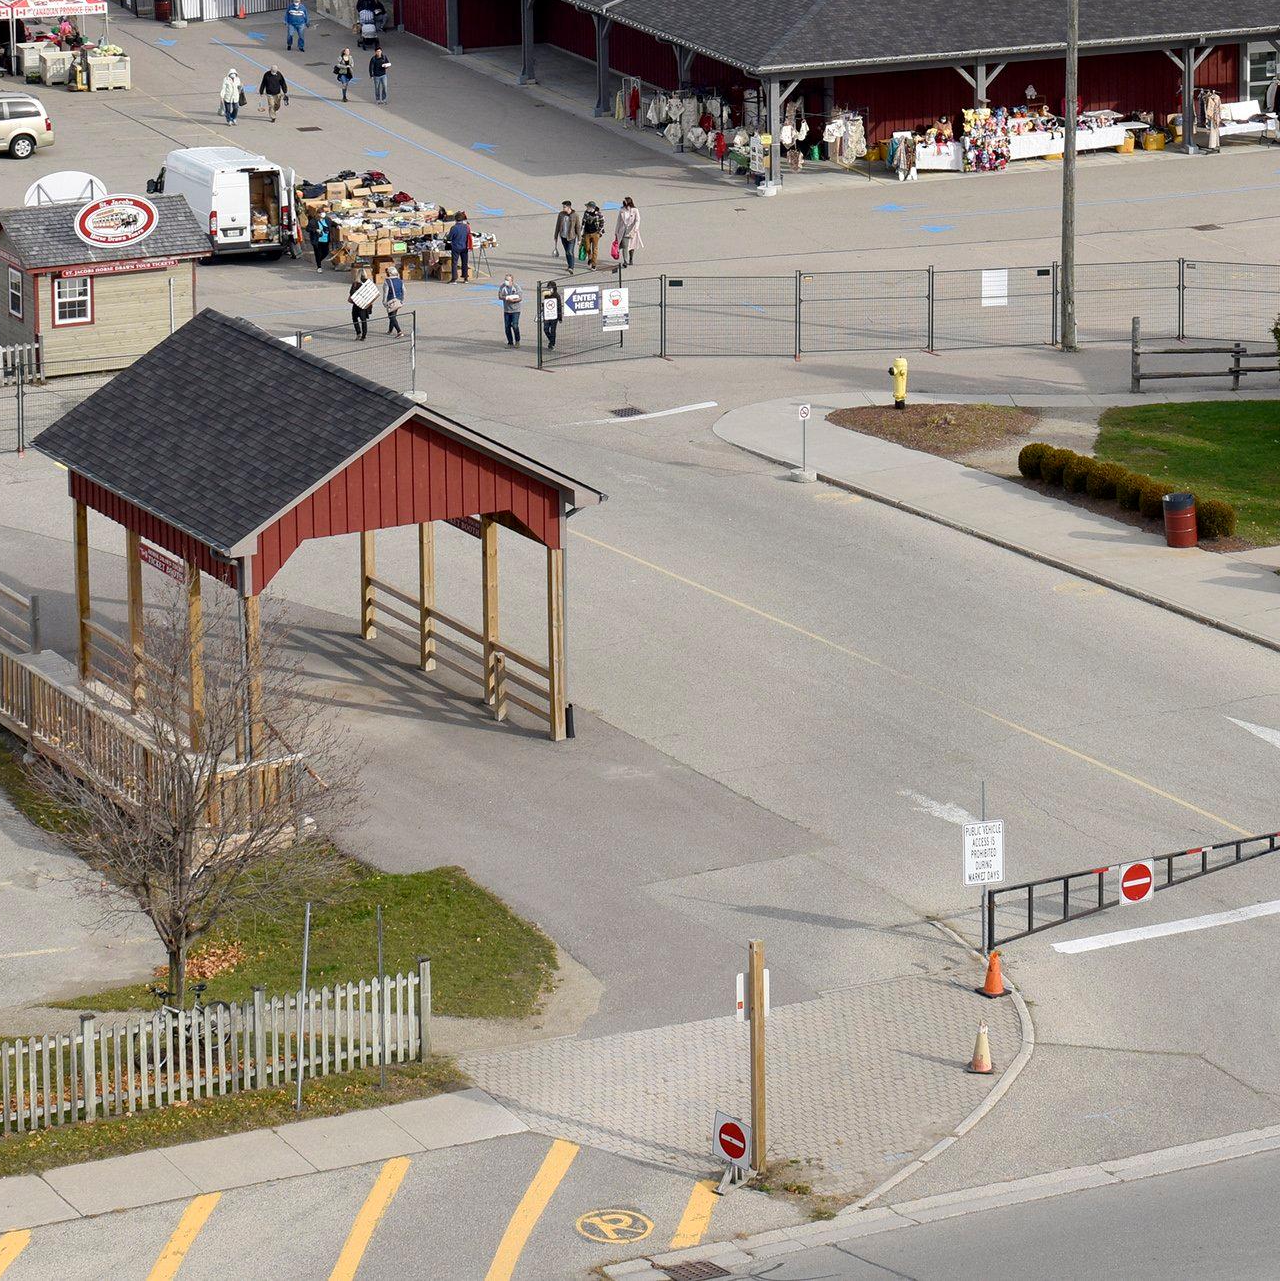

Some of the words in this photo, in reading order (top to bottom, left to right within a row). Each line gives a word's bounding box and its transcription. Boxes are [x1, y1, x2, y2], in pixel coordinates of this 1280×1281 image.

[127, 228, 144, 238] Tours
[572, 293, 597, 302] ENTER
[574, 301, 595, 309] HERE
[966, 826, 981, 837] PUBLIC
[982, 823, 1001, 835] VEHICLE
[972, 837, 989, 847] ACCESS
[971, 848, 997, 859] PROHIBITED
[975, 860, 993, 870] DURING
[968, 871, 986, 882] MARKET
[987, 870, 1000, 880] DAYS
